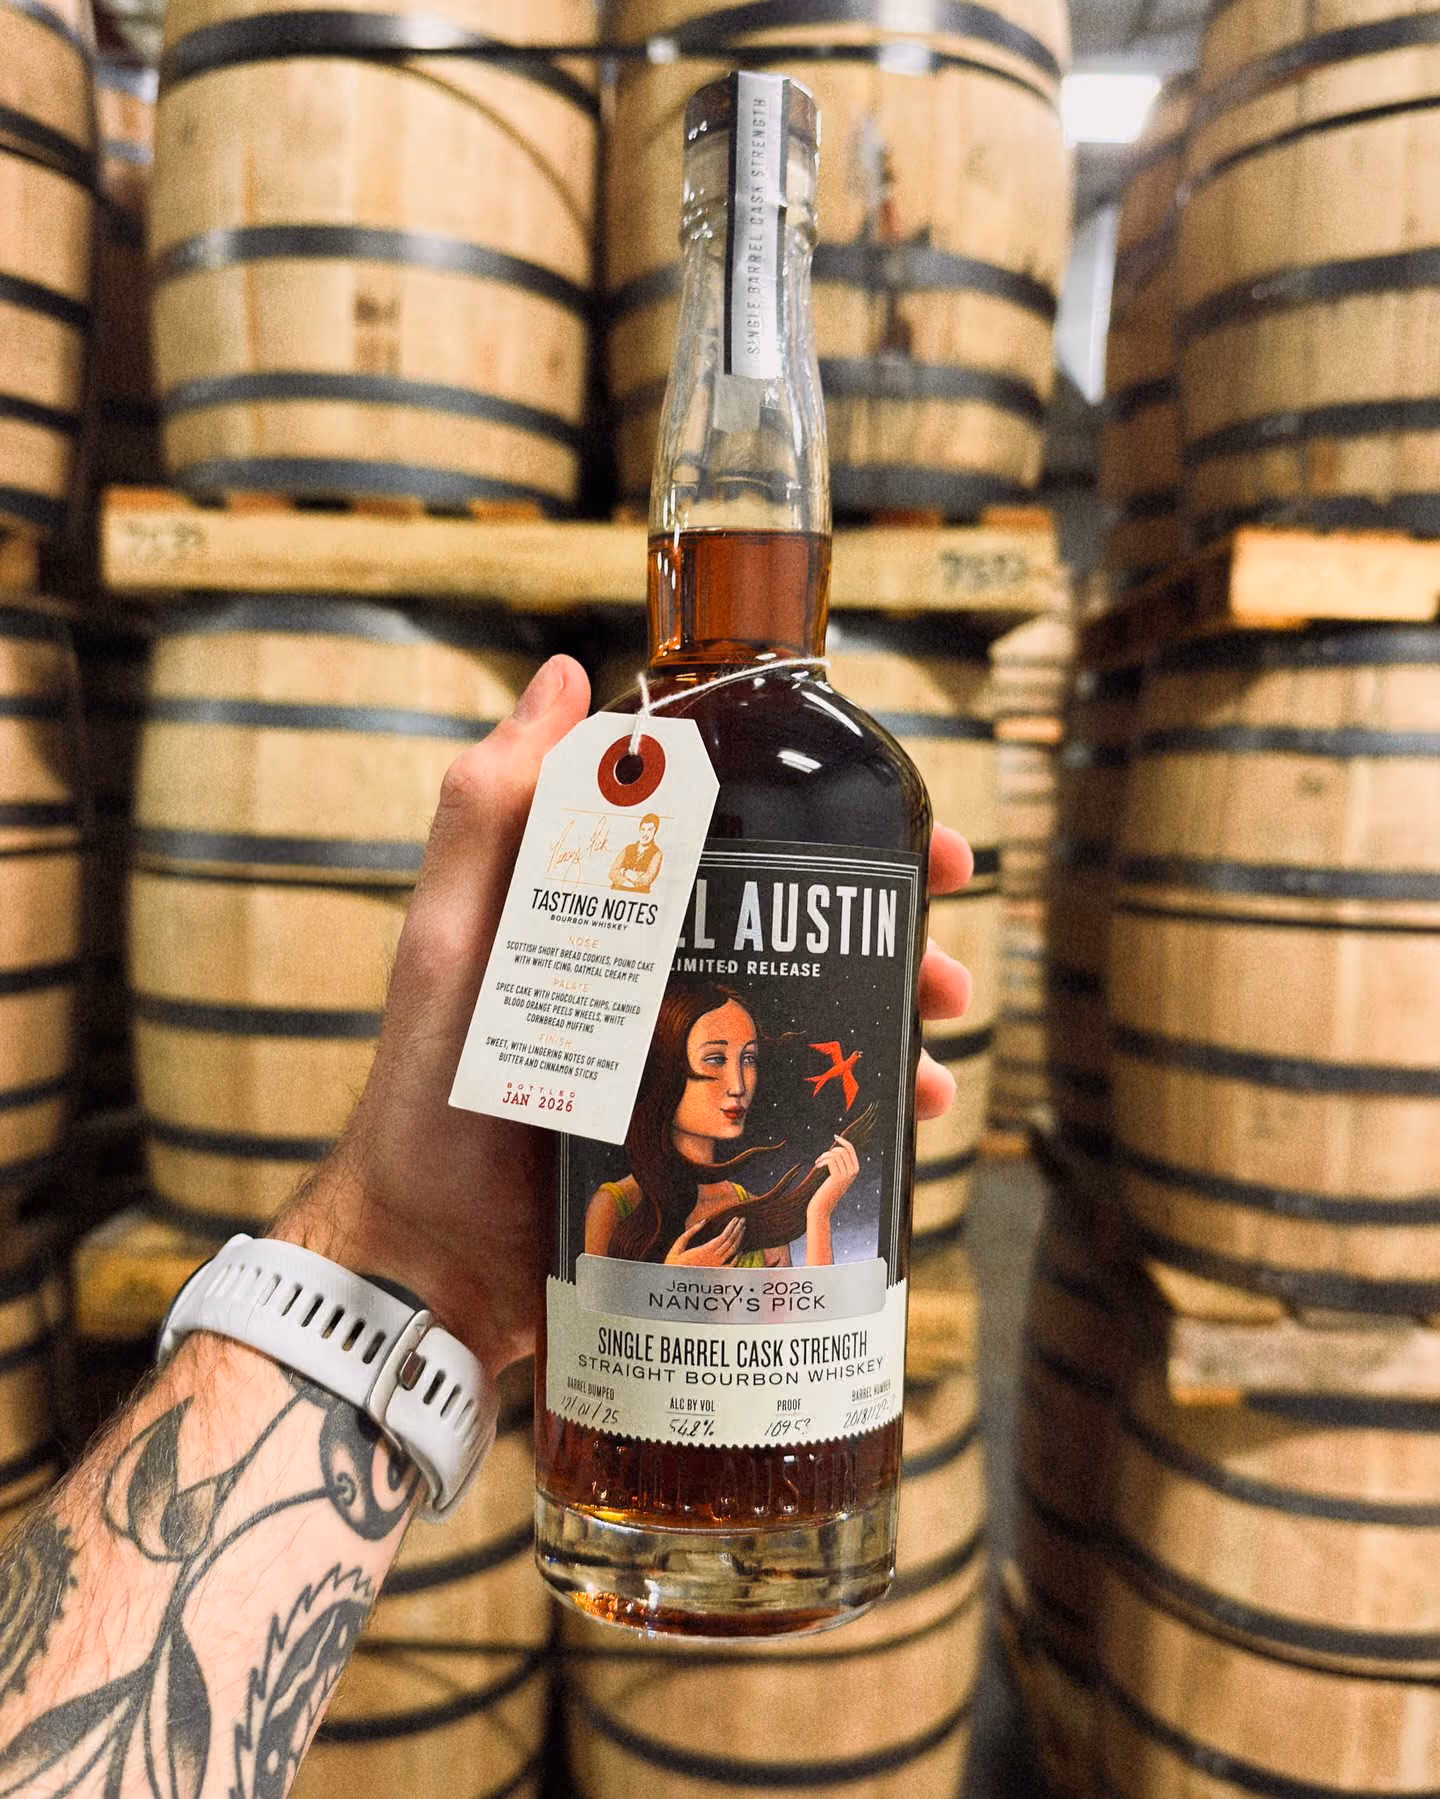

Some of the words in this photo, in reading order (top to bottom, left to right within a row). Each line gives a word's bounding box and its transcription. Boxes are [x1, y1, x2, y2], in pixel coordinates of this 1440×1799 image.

[751, 98, 767, 178] STRENGTH
[750, 186, 765, 225] CASK
[748, 234, 763, 293] BARREL
[746, 301, 761, 355] SINGLE
[531, 888, 599, 917] TASTING
[601, 898, 658, 926] NOTES
[734, 880, 898, 958] AUSTIN
[550, 914, 590, 926] BOURBON
[591, 920, 629, 932] WHISKEY
[506, 940, 537, 953] SCOTTISH
[538, 945, 559, 957] SHORT
[560, 949, 582, 961] BREAD
[582, 952, 612, 965] COOKIES,
[613, 956, 636, 969] POUND
[637, 960, 656, 972] CAKE
[568, 936, 600, 949] NOSE
[514, 954, 531, 965] WITH
[532, 958, 552, 969] WHITE
[574, 964, 603, 977] OATMEAL
[604, 968, 627, 980] CREAM
[628, 972, 640, 984] PIE
[747, 961, 822, 978] RELEASE
[495, 982, 515, 993] SPICE
[516, 985, 533, 997] CAKE
[534, 988, 550, 1000] WITH
[551, 991, 589, 1007] CHOCOLATE
[612, 1002, 641, 1015] CANDIED
[552, 977, 590, 992] PALATE
[504, 996, 525, 1008] BLOOD
[526, 1000, 552, 1013] ORANGE
[552, 1004, 574, 1016] PEELS
[604, 1014, 626, 1026] WHITE
[526, 1012, 565, 1029] CORNBREAD
[566, 1020, 596, 1034] MUFFINS
[486, 1036, 509, 1050] SWEET,
[510, 1041, 528, 1053] WITH
[528, 1044, 562, 1060] LINGERING
[564, 1050, 586, 1064] NOTES
[586, 1055, 596, 1066] OF
[596, 1058, 620, 1072] HONEY
[538, 1033, 573, 1048] FINISH
[498, 1052, 524, 1065] BUTTER
[524, 1058, 538, 1068] AND
[540, 1060, 573, 1075] CINNAMON
[574, 1066, 599, 1081] STICKS
[502, 1091, 530, 1107] JAN
[538, 1096, 574, 1113] 2026
[506, 1082, 576, 1098] BOTTLED
[649, 1292, 761, 1312] NANCY'S
[772, 1294, 826, 1312] PICK
[666, 1279, 744, 1299] January
[762, 1280, 814, 1296] 2026
[598, 1326, 654, 1362] SINGLE
[660, 1336, 730, 1368] BARREL
[736, 1339, 784, 1368] CASK
[789, 1329, 868, 1366] STRENGTH
[578, 1354, 676, 1383] STRAIGHT
[685, 1371, 799, 1387] BOURBON
[808, 1356, 884, 1383] WHISKEY
[588, 1383, 615, 1400] DUMPED
[669, 1397, 684, 1410] ALC
[687, 1398, 698, 1412] BY
[700, 1400, 716, 1412] VOL
[777, 1398, 802, 1411] PROOF
